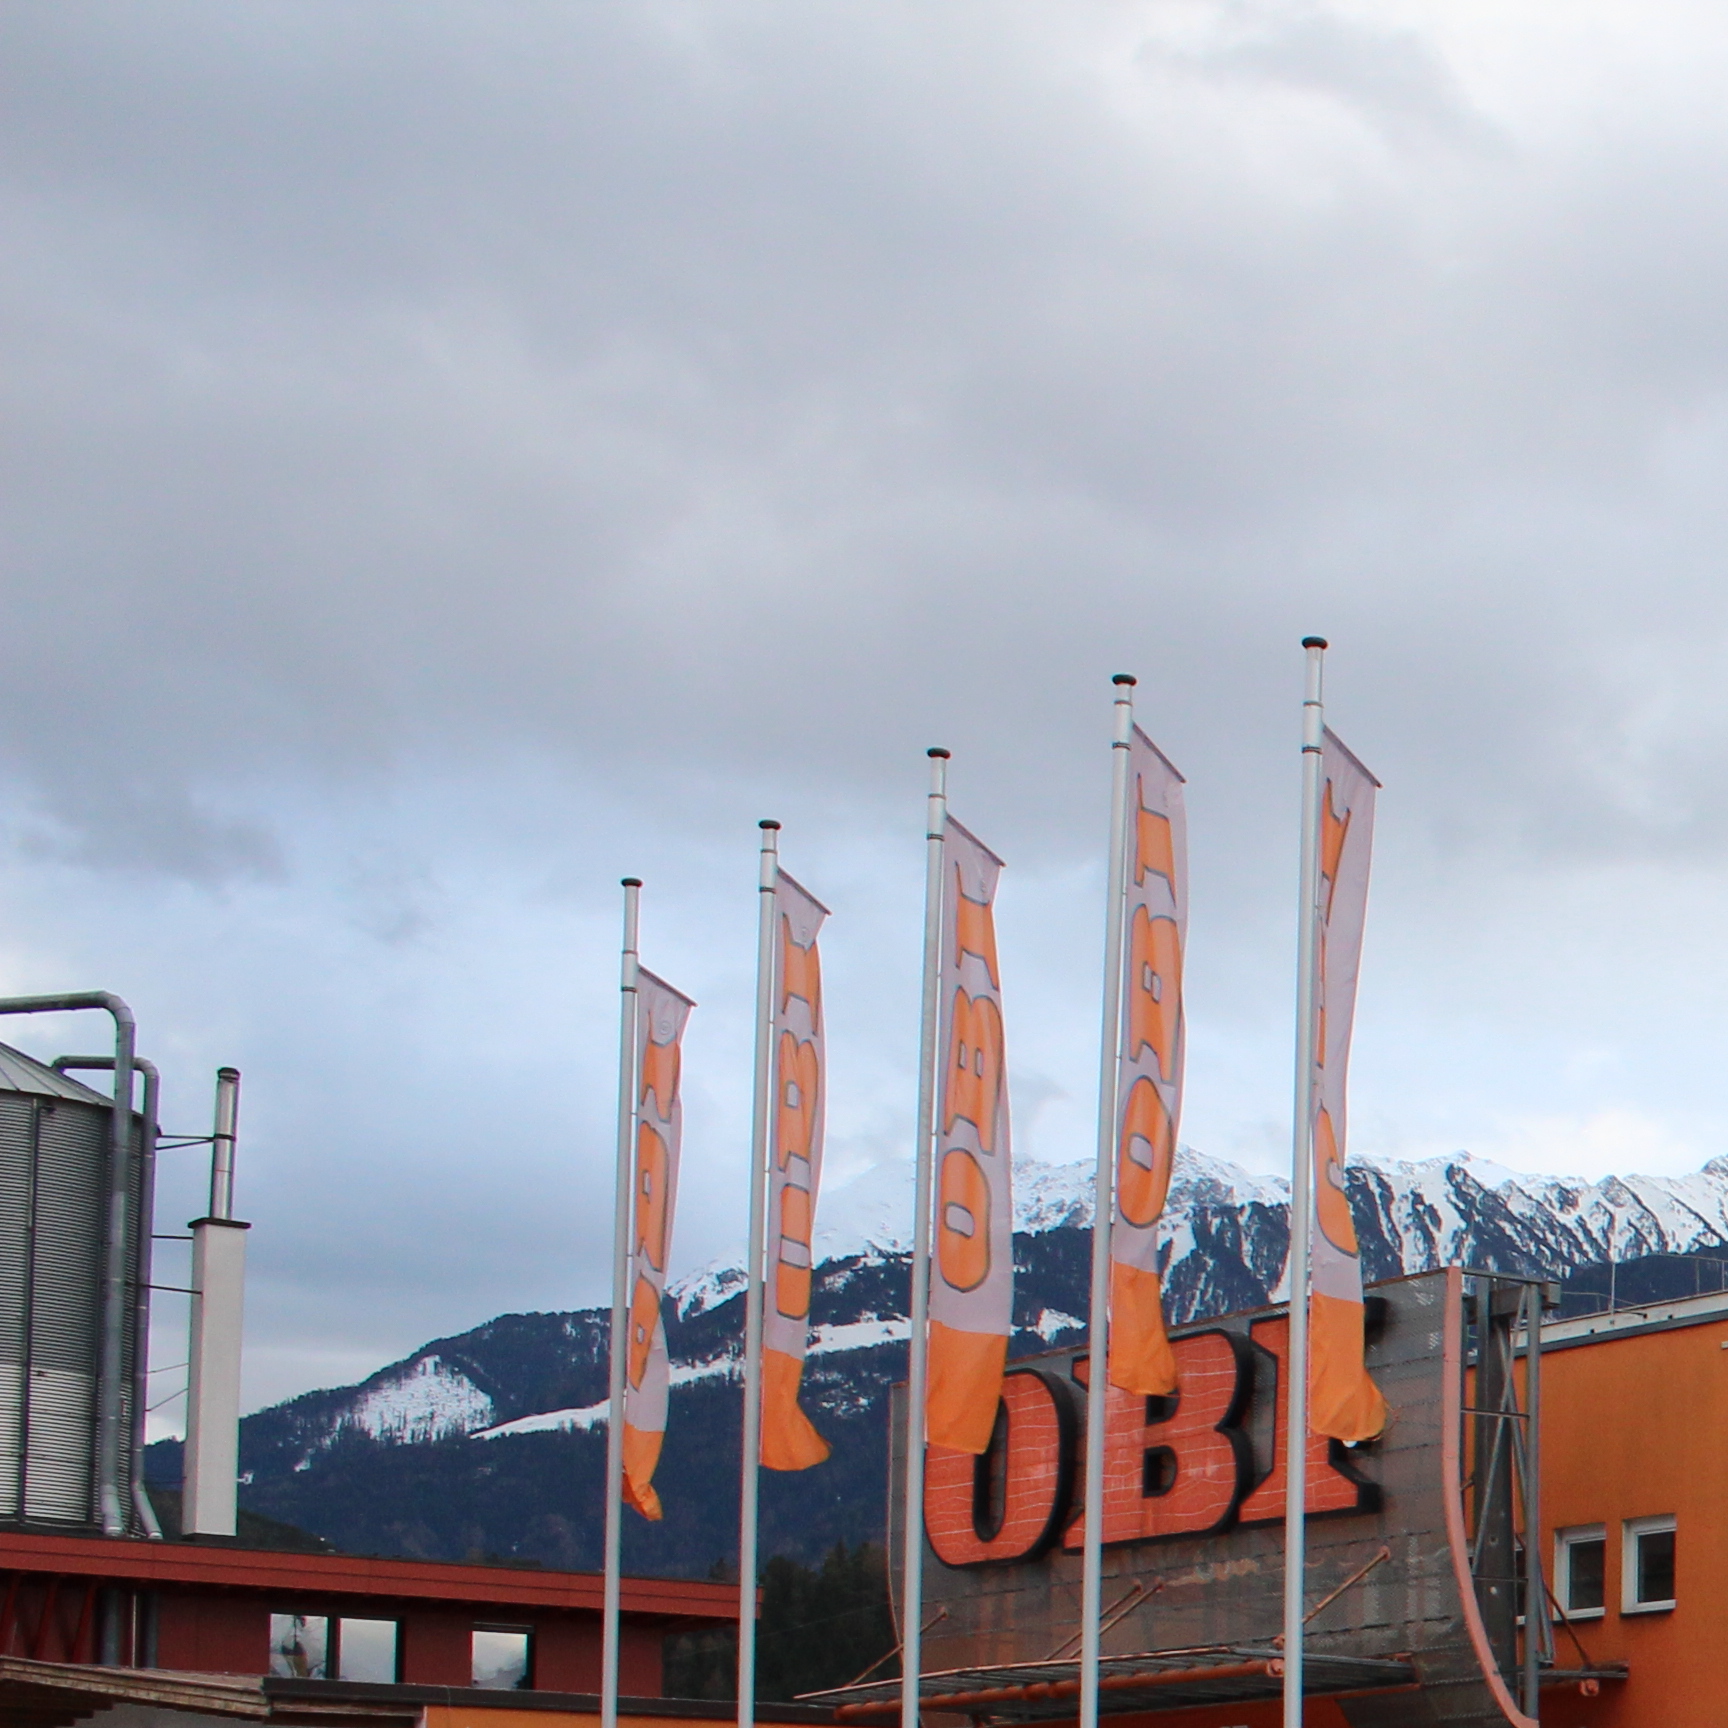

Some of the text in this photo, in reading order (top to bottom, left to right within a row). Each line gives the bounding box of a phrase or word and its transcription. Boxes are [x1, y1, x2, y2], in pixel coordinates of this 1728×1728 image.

[938, 861, 1003, 1292] OBI
[1116, 774, 1180, 1229] OBI
[922, 1312, 1378, 1567] OBI
